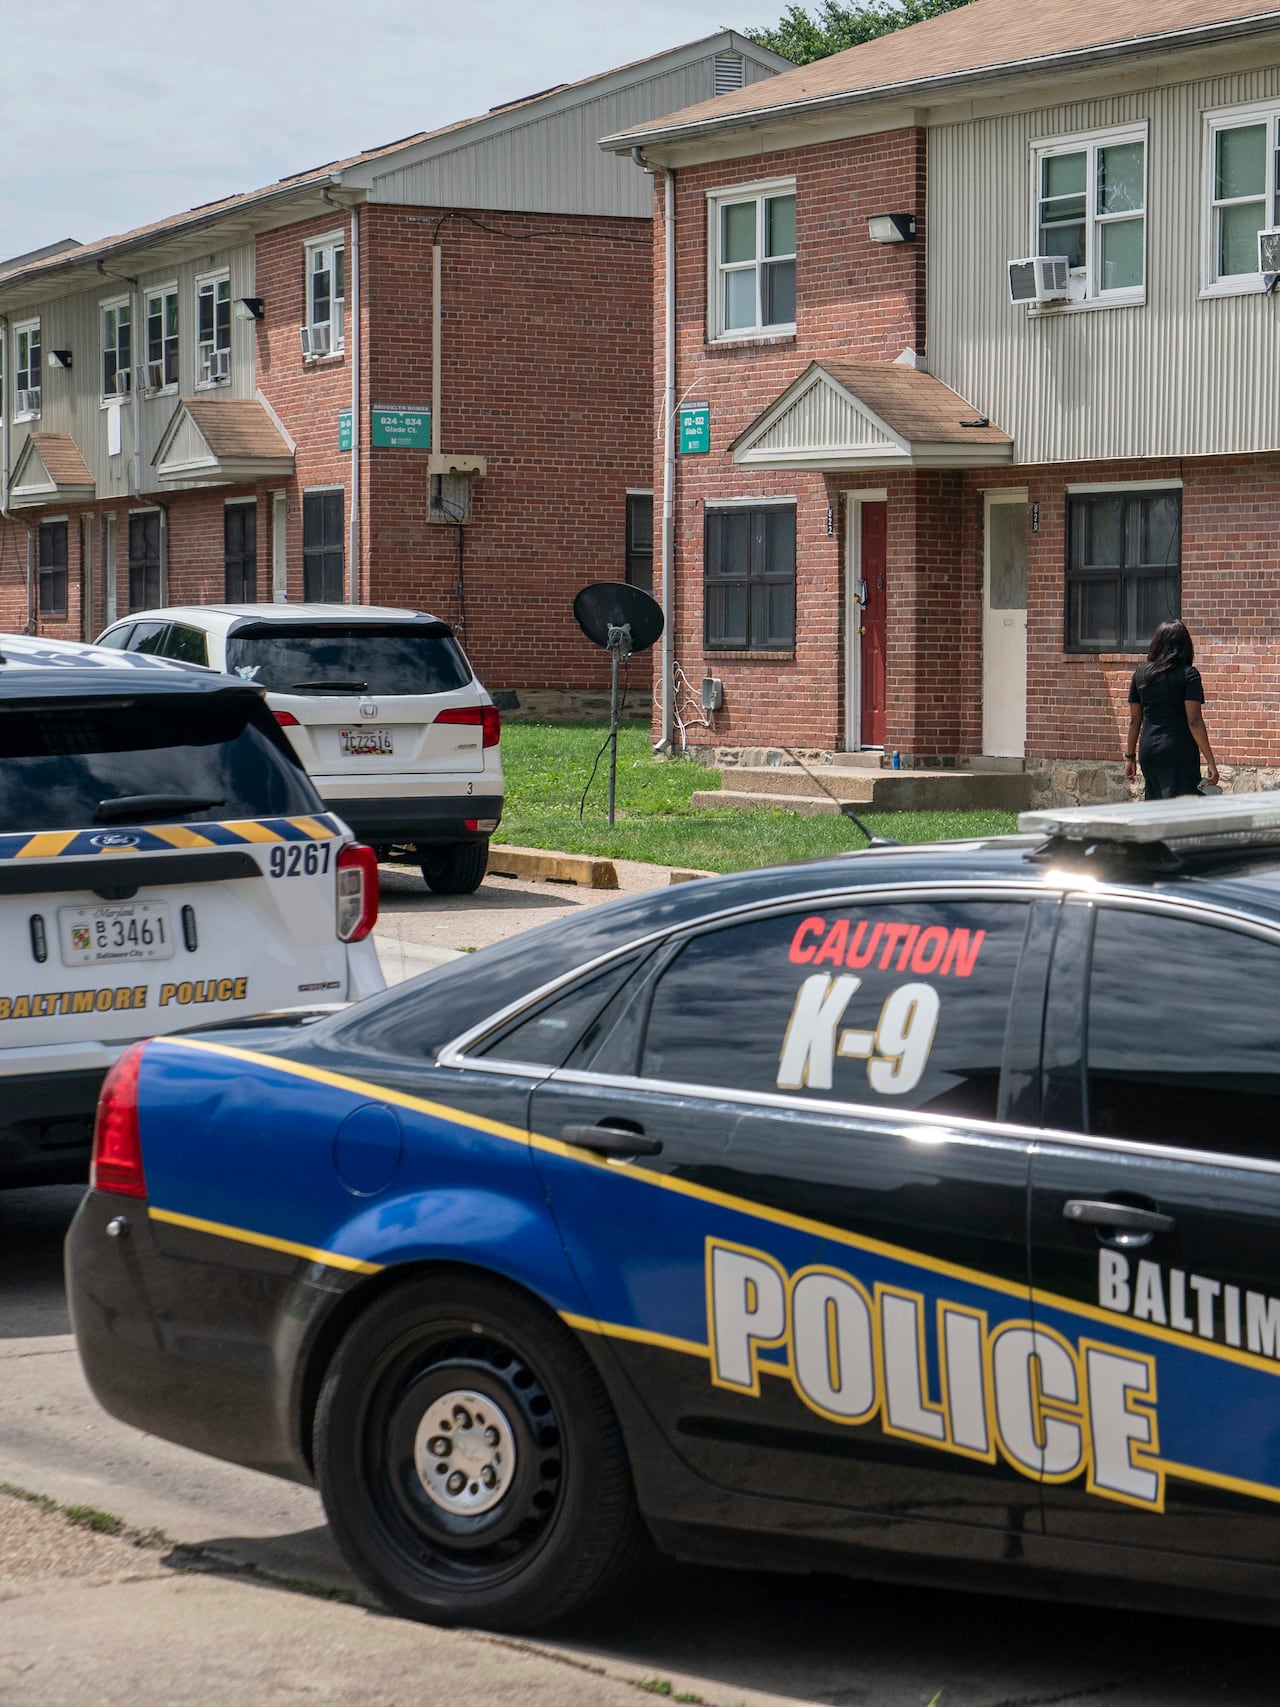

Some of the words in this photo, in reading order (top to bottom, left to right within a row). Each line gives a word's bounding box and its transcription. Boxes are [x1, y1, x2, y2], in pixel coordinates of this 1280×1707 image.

[380, 417, 397, 425] 824
[405, 418, 422, 426] 834
[466, 782, 473, 794] 3
[269, 842, 331, 878] 9267
[112, 917, 165, 946] 3461
[788, 916, 987, 977] CAUTION
[129, 950, 144, 958] City
[0, 985, 148, 1020] BALTIMORE
[159, 976, 249, 1007] POLICE
[776, 971, 941, 1095] K-9
[705, 1235, 1166, 1514] POLICE
